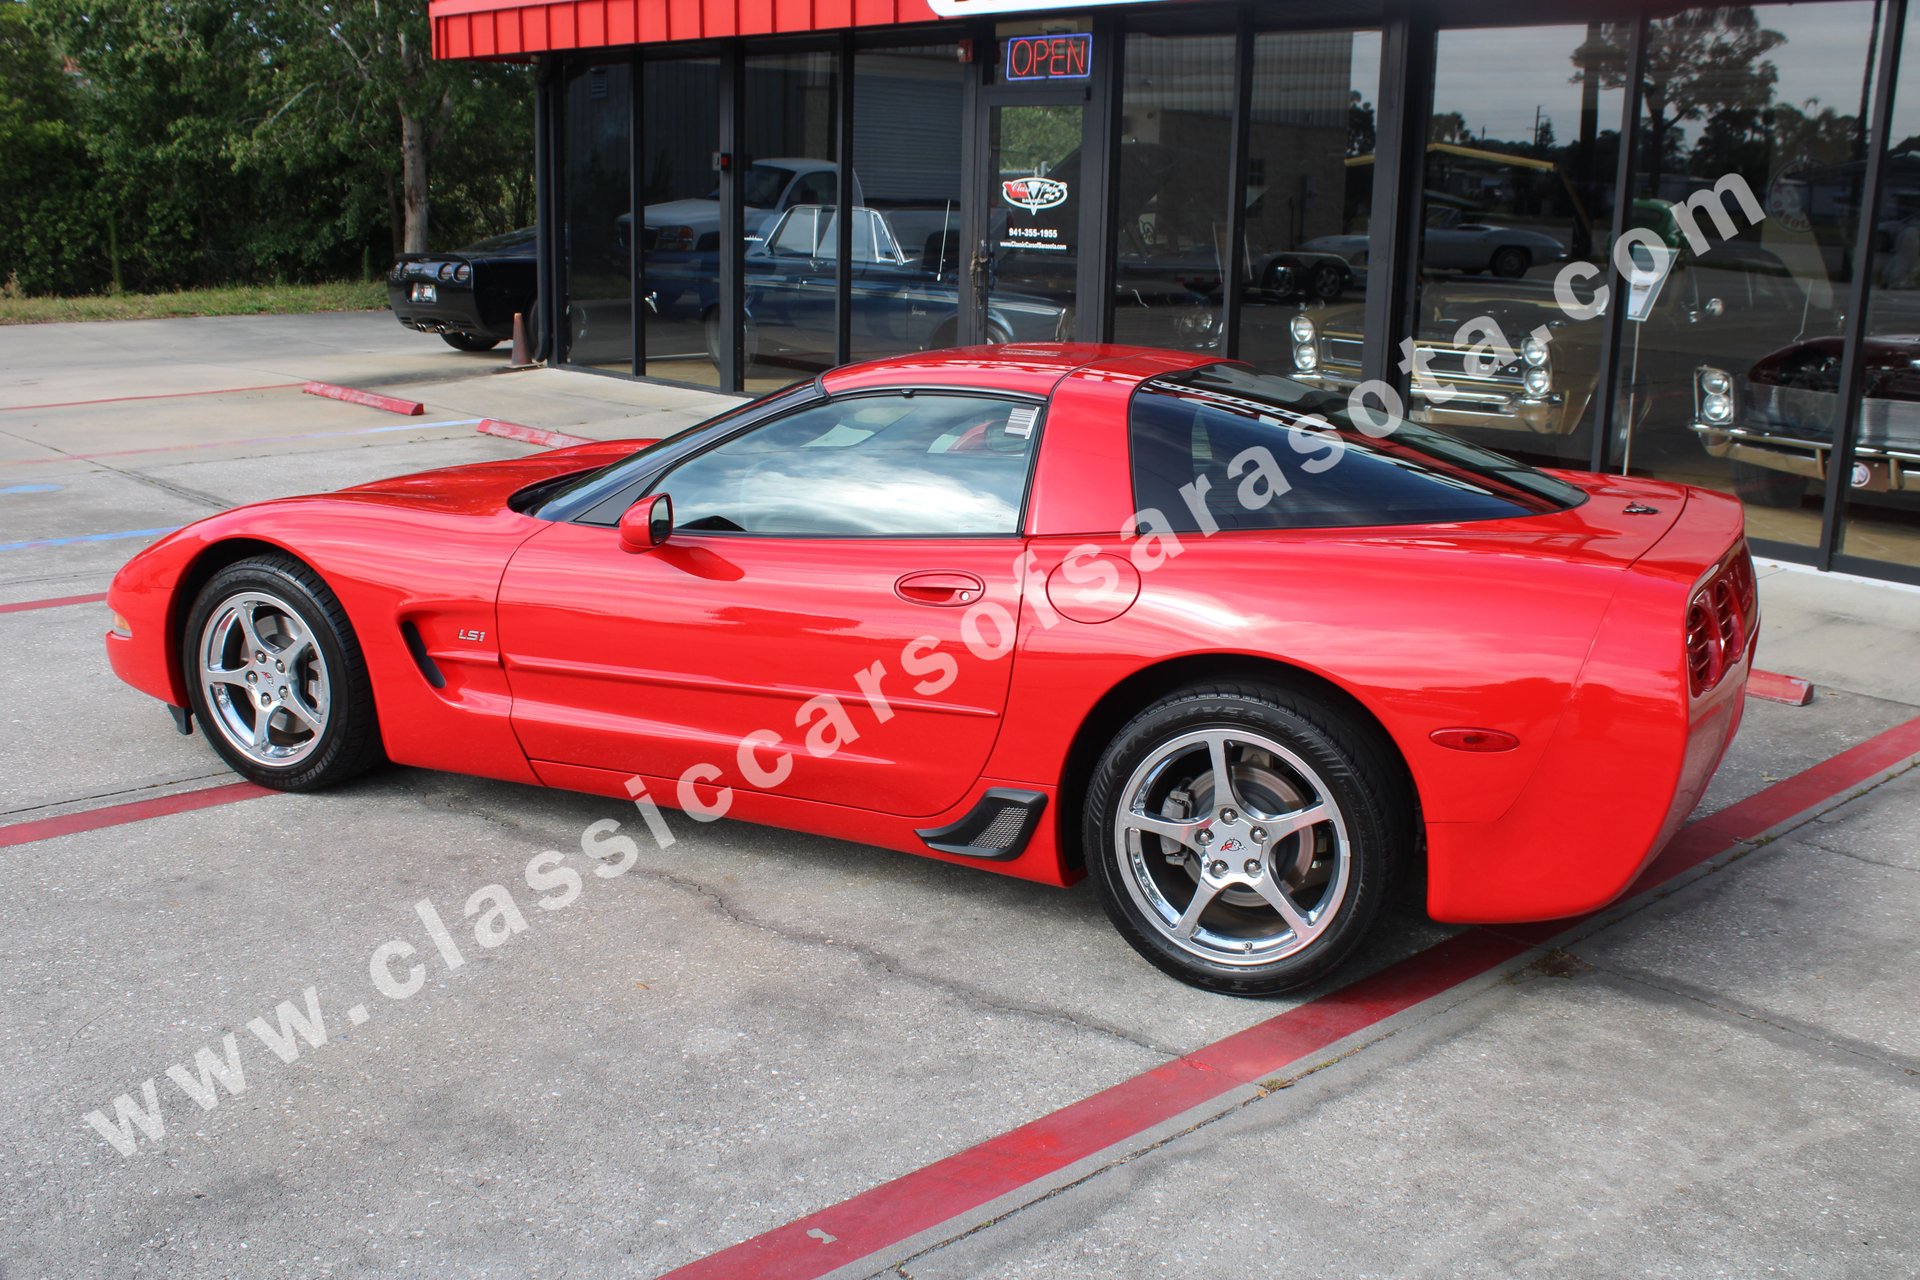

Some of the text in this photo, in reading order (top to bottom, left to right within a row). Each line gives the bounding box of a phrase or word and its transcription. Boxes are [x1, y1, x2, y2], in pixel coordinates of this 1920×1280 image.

[1011, 39, 1085, 75] OPEN
[1009, 228, 1058, 238] 941-355-1955
[1479, 363, 1519, 373] GTO
[458, 629, 486, 642] LS1
